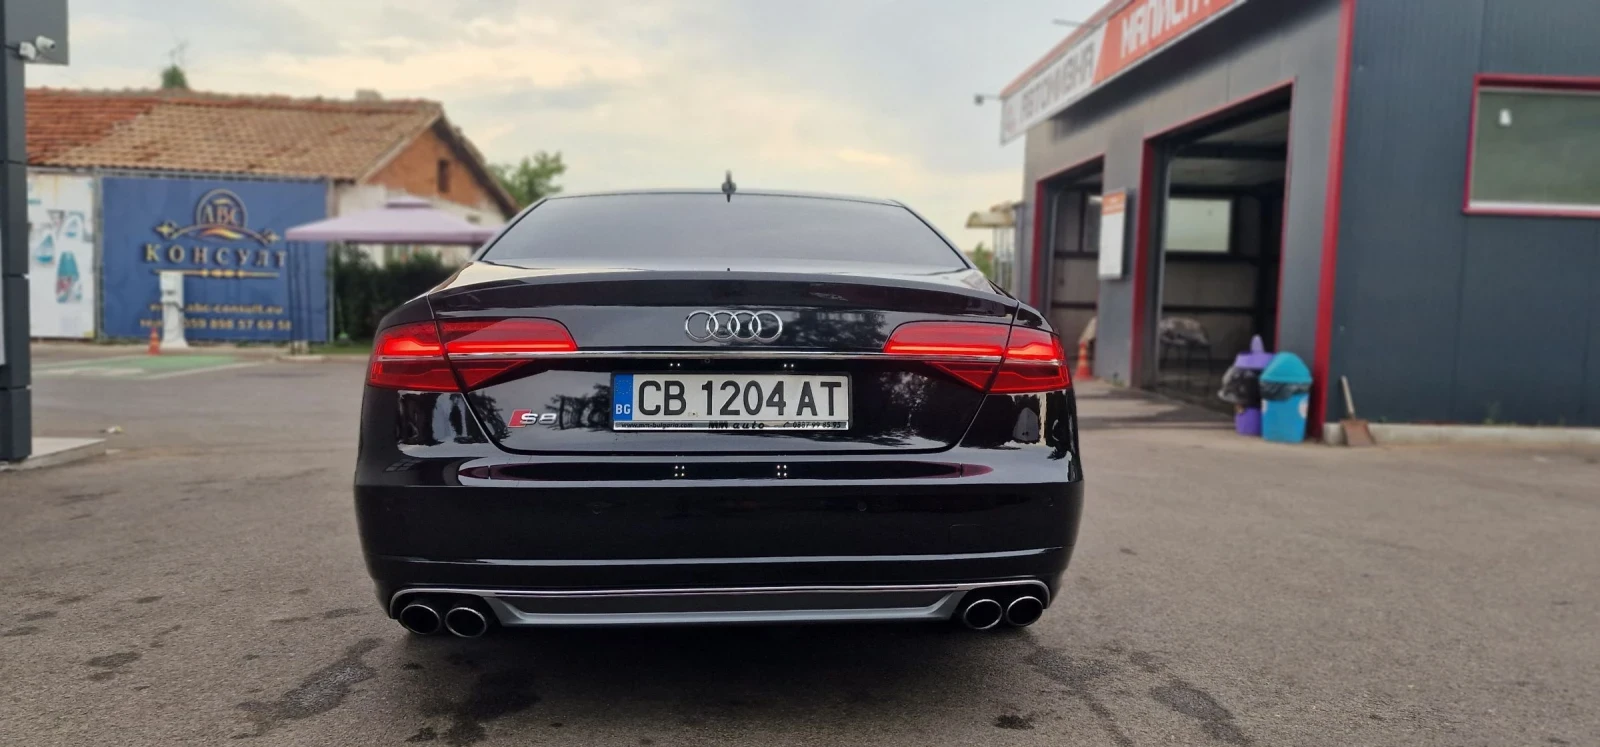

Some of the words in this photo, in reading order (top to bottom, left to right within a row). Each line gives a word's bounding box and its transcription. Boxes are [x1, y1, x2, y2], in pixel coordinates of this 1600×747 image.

[144, 243, 287, 268] КОНСУЛТ
[638, 380, 687, 416] CB
[701, 380, 787, 416] 1204
[796, 381, 842, 416] AT
[615, 404, 631, 415] BG
[520, 413, 557, 425] S8
[733, 420, 765, 429] auto
